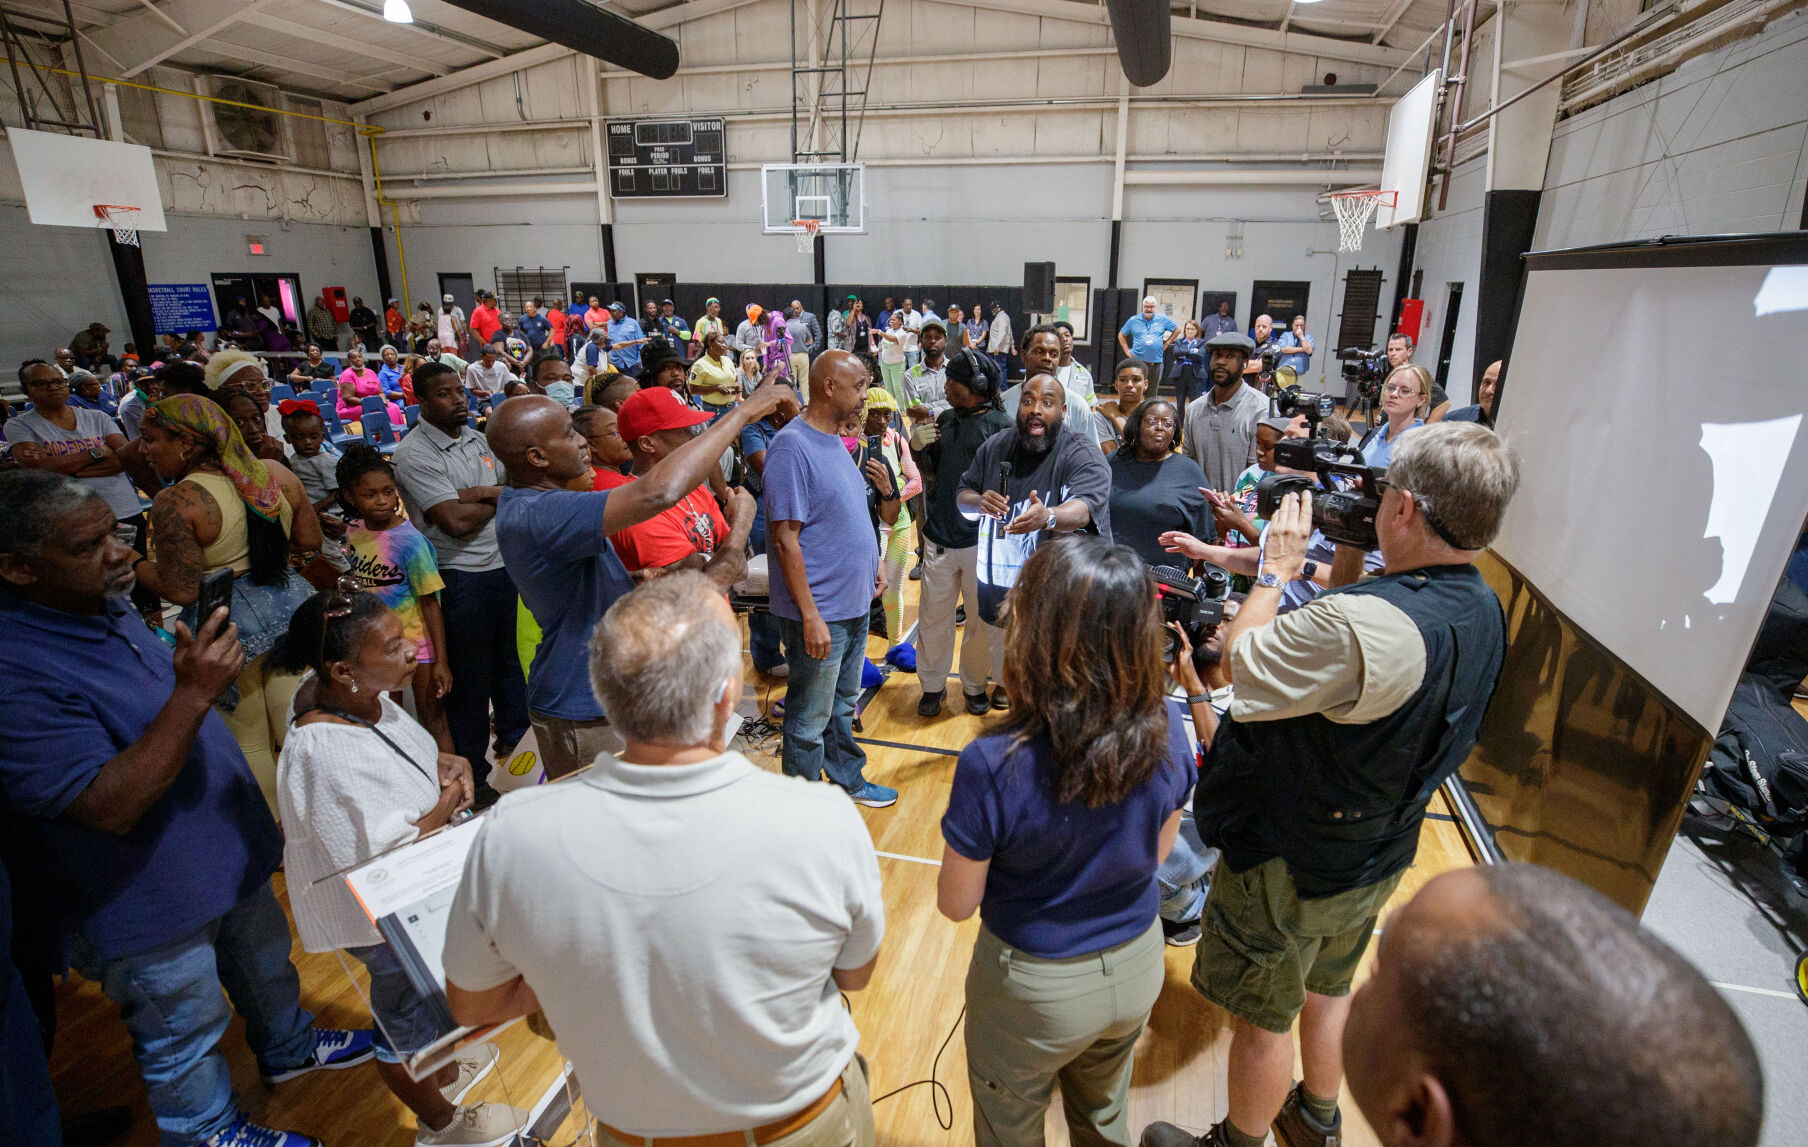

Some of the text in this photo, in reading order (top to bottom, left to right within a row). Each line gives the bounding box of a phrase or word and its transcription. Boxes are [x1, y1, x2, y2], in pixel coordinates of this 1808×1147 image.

[611, 125, 631, 134] HOME
[692, 121, 721, 132] VISITOR
[650, 152, 670, 160] PERIOD
[693, 155, 712, 163] BONUS
